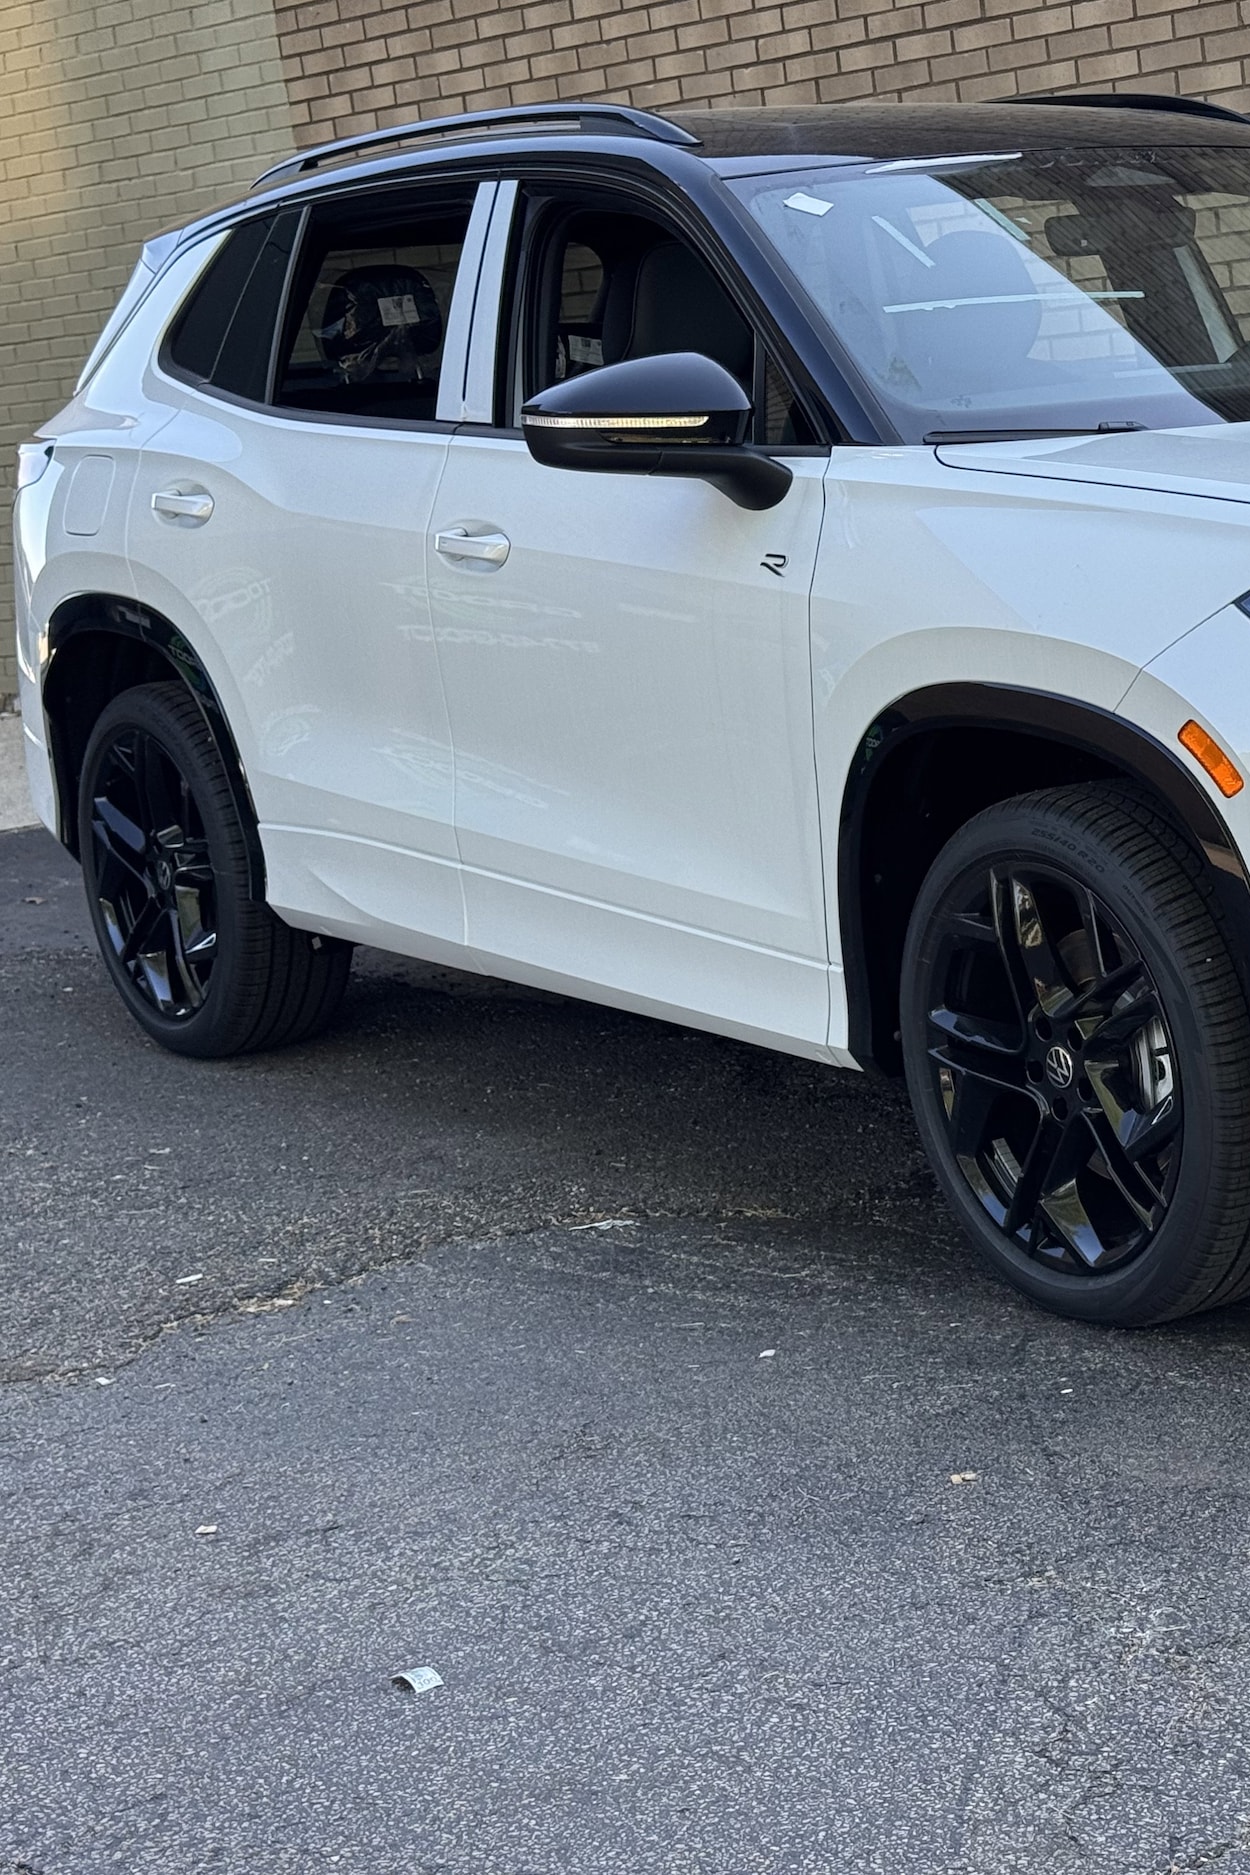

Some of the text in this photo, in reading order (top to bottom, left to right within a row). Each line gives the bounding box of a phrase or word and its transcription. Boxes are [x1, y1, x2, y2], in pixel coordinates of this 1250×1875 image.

[760, 553, 790, 578] R
[1031, 827, 1105, 873] 255/40 R20
[1046, 1046, 1072, 1088] VW
